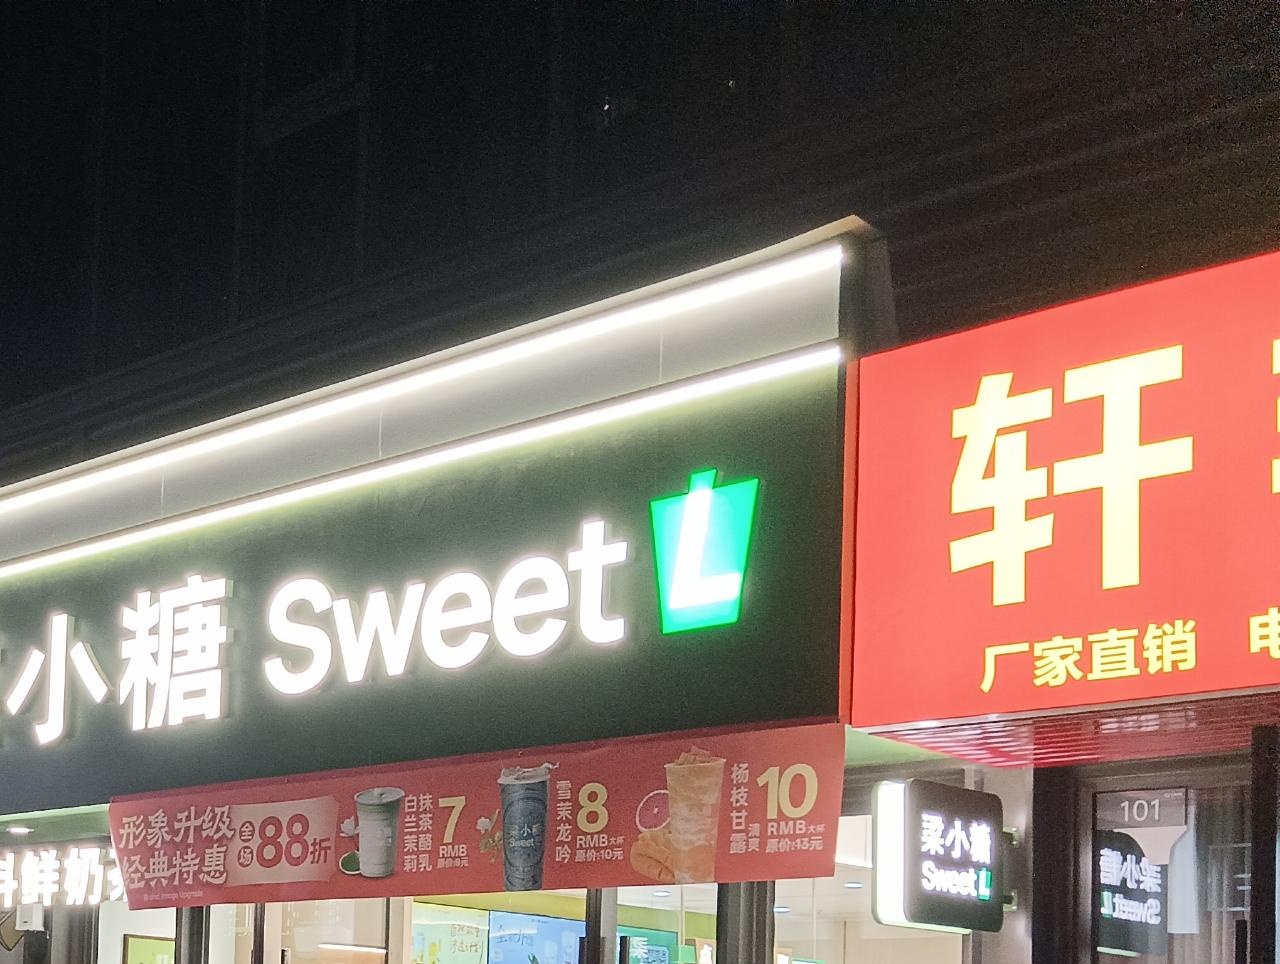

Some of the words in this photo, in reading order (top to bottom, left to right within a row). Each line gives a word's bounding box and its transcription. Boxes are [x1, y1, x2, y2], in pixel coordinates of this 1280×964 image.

[949, 344, 1280, 606] 轩
[264, 519, 631, 696] Sweet
[979, 619, 1197, 694] 厂家直销
[576, 782, 609, 833] 8
[729, 763, 749, 854] 杨枝甘露
[756, 763, 818, 819] 10
[1121, 800, 1161, 822] 101
[119, 805, 236, 849] 形象升级
[237, 820, 256, 868] 全场
[403, 795, 419, 874] 白兰茉莉
[438, 796, 466, 844] 7
[556, 781, 572, 864] 雪茉龙吟
[577, 834, 608, 848] RMB
[768, 820, 806, 836] RMB
[123, 843, 228, 890] 经典特惠
[439, 845, 467, 858] RMB
[921, 860, 978, 897] Sweet
